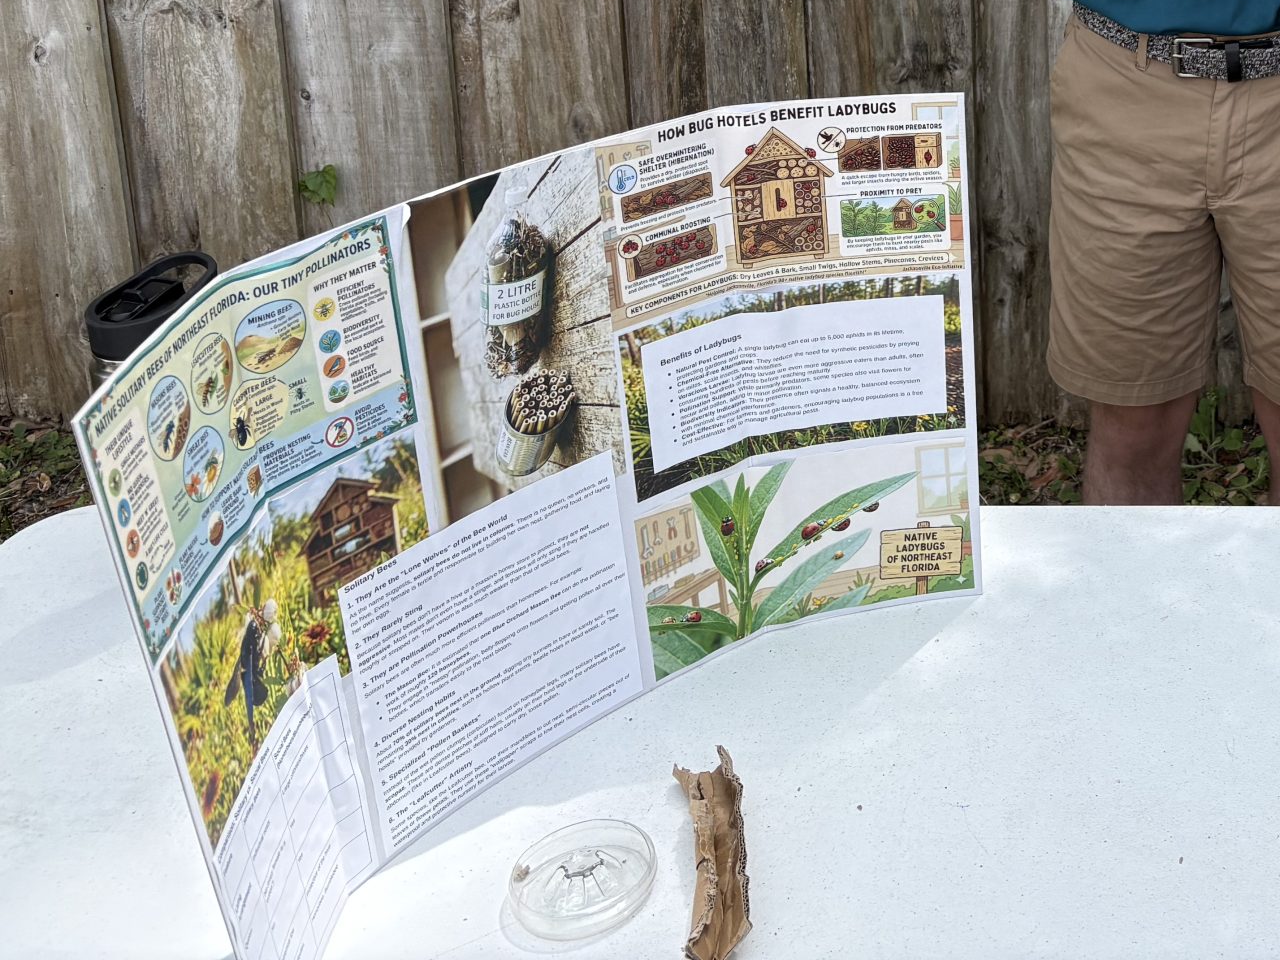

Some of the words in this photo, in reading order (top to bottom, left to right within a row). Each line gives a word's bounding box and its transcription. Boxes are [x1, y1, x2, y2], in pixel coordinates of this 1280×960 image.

[658, 125, 685, 142] HOW
[689, 118, 713, 134] BUG
[718, 113, 766, 127] HOTELS
[770, 106, 824, 121] BENEFIT
[828, 102, 896, 117] LADYBUGS
[639, 158, 655, 167] SAFE
[656, 143, 706, 161] OVERWINTERING
[639, 162, 667, 175] SHELTER
[668, 148, 714, 169] (HIBERNATION)
[645, 226, 679, 241] COMMUNAL
[680, 217, 711, 231] ROOSTING
[313, 280, 329, 292] WHY
[330, 272, 348, 284] THEY
[349, 262, 376, 276] MATTER
[498, 290, 503, 299] 2
[508, 280, 536, 297] LITRE
[631, 305, 643, 314] KEY
[645, 290, 688, 309] COMPONENTS
[689, 286, 702, 295] FOR
[703, 274, 739, 291] LADYBUGS:
[752, 271, 773, 279] Leaves
[248, 311, 276, 325] MINING
[277, 304, 293, 316] BEES
[494, 300, 520, 309] PLASTIC
[507, 310, 520, 318] BUG
[522, 300, 540, 314] HOUSE
[343, 314, 380, 333] BIODIVERSITY
[95, 407, 117, 437] NATIVE
[116, 371, 146, 412] SOLITARY
[146, 355, 163, 382] BEES
[164, 348, 172, 363] OF
[173, 316, 209, 355] NORTHEAST
[209, 291, 250, 324] FLORIDA:
[253, 282, 278, 298] OUR
[281, 270, 304, 289] TINY
[305, 238, 371, 278] POLLINATORS
[660, 351, 692, 366] Benefits
[694, 346, 702, 354] of
[704, 334, 742, 351] Ladybugs
[896, 542, 945, 552] LADYBUGS
[905, 532, 937, 542] NATIVE
[355, 591, 372, 604] They
[374, 583, 387, 593] Are
[388, 575, 400, 585] the
[461, 534, 472, 544] the
[473, 528, 487, 537] Bee
[488, 514, 508, 528] World
[888, 555, 898, 563] OF
[901, 552, 952, 562] NORTHEAST
[902, 563, 940, 573] FLORIDA
[344, 571, 375, 594] Solitary
[376, 560, 397, 574] Bees
[370, 670, 387, 683] They
[389, 662, 399, 671] are
[401, 638, 436, 663] Pollination
[438, 611, 483, 640] Powerhouses
[382, 724, 406, 742] Diverse
[408, 706, 434, 724] Nesting
[435, 691, 456, 706] Habits
